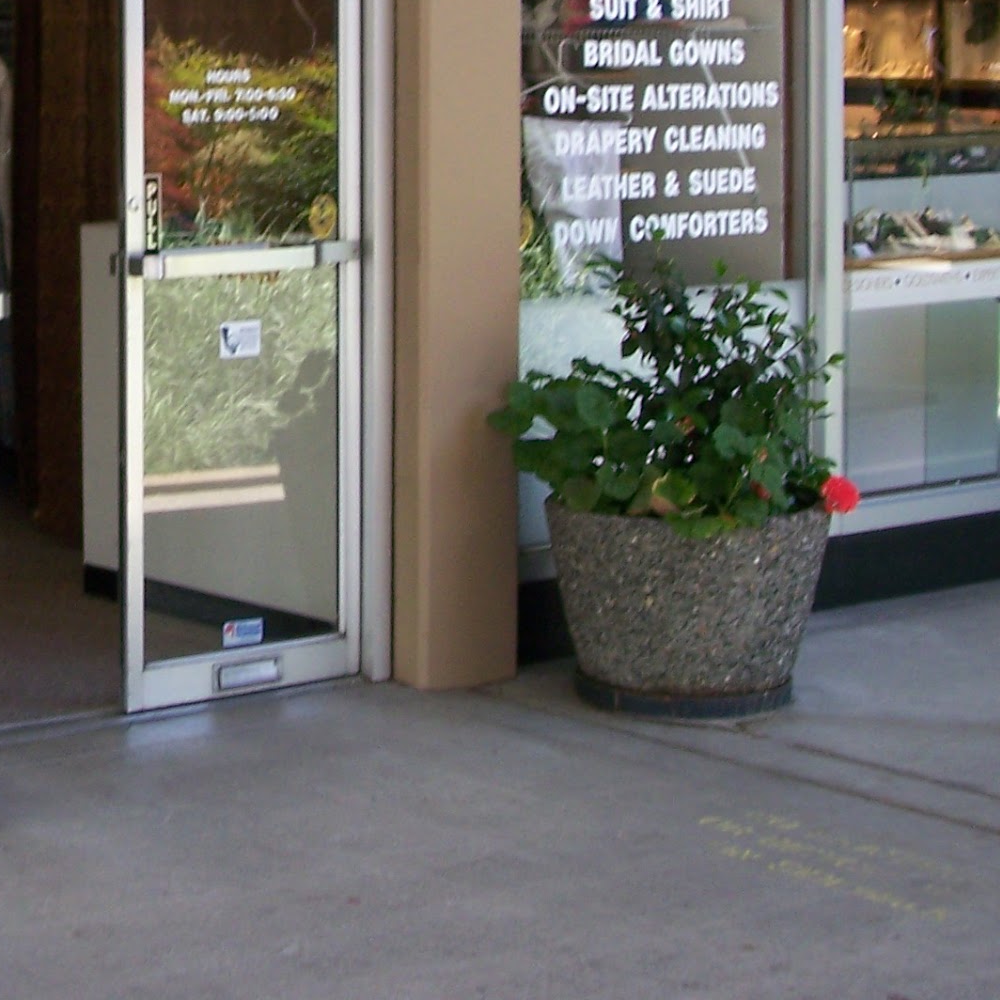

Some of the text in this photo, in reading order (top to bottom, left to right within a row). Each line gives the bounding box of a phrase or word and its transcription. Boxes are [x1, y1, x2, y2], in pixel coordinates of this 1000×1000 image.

[583, 36, 747, 68] BRIDAL GOWNS
[543, 80, 780, 115] ON-SITE ALTERATIONS
[554, 122, 767, 157] DRAPERY CLEANING
[560, 166, 757, 201] LEATHER & SUEDE
[145, 180, 159, 250] PULL
[552, 206, 769, 249] DOWN COMFORTERS
